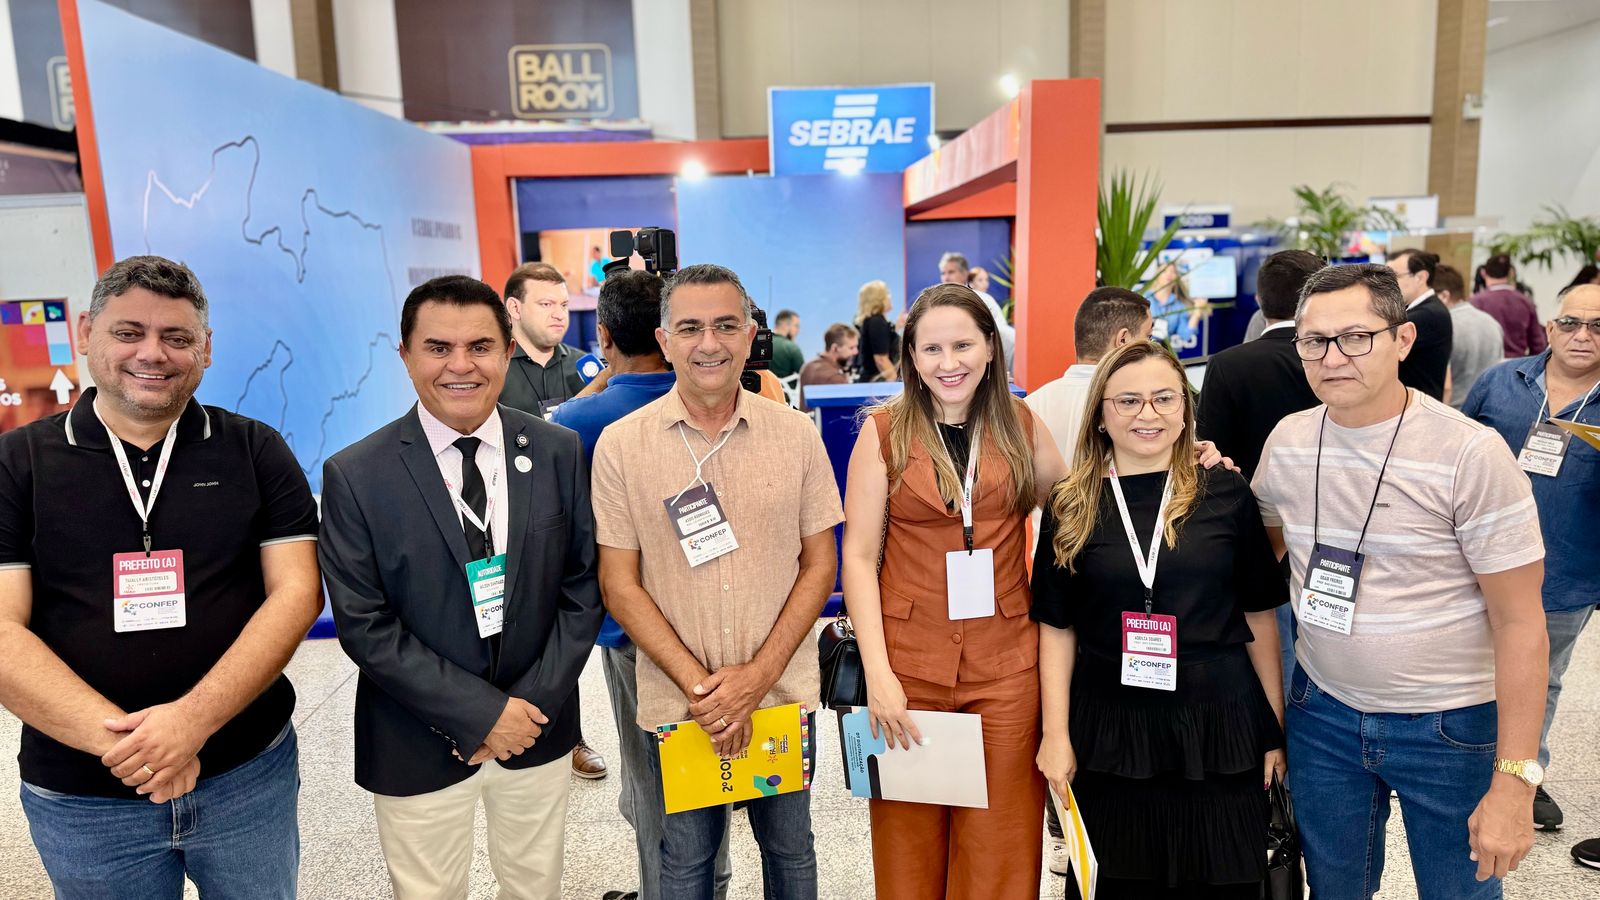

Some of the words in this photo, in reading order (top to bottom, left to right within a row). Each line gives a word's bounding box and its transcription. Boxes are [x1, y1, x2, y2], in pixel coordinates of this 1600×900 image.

[517, 52, 603, 81] BALL
[520, 82, 605, 110] ROOM
[788, 117, 916, 147] SEBRAE
[678, 497, 708, 514] PARTICIPANTE
[700, 528, 727, 543] CONFEP
[119, 558, 160, 571] PREFEITO
[162, 557, 176, 568] (A)
[1319, 558, 1351, 574] PARTICIPANTE
[139, 600, 178, 609] CONFEP
[1320, 599, 1349, 613] CONFEP
[1126, 618, 1158, 630] PREFEITO
[1160, 621, 1171, 631] (A)
[1140, 660, 1171, 669] CONFEP
[722, 782, 733, 792] 2º
